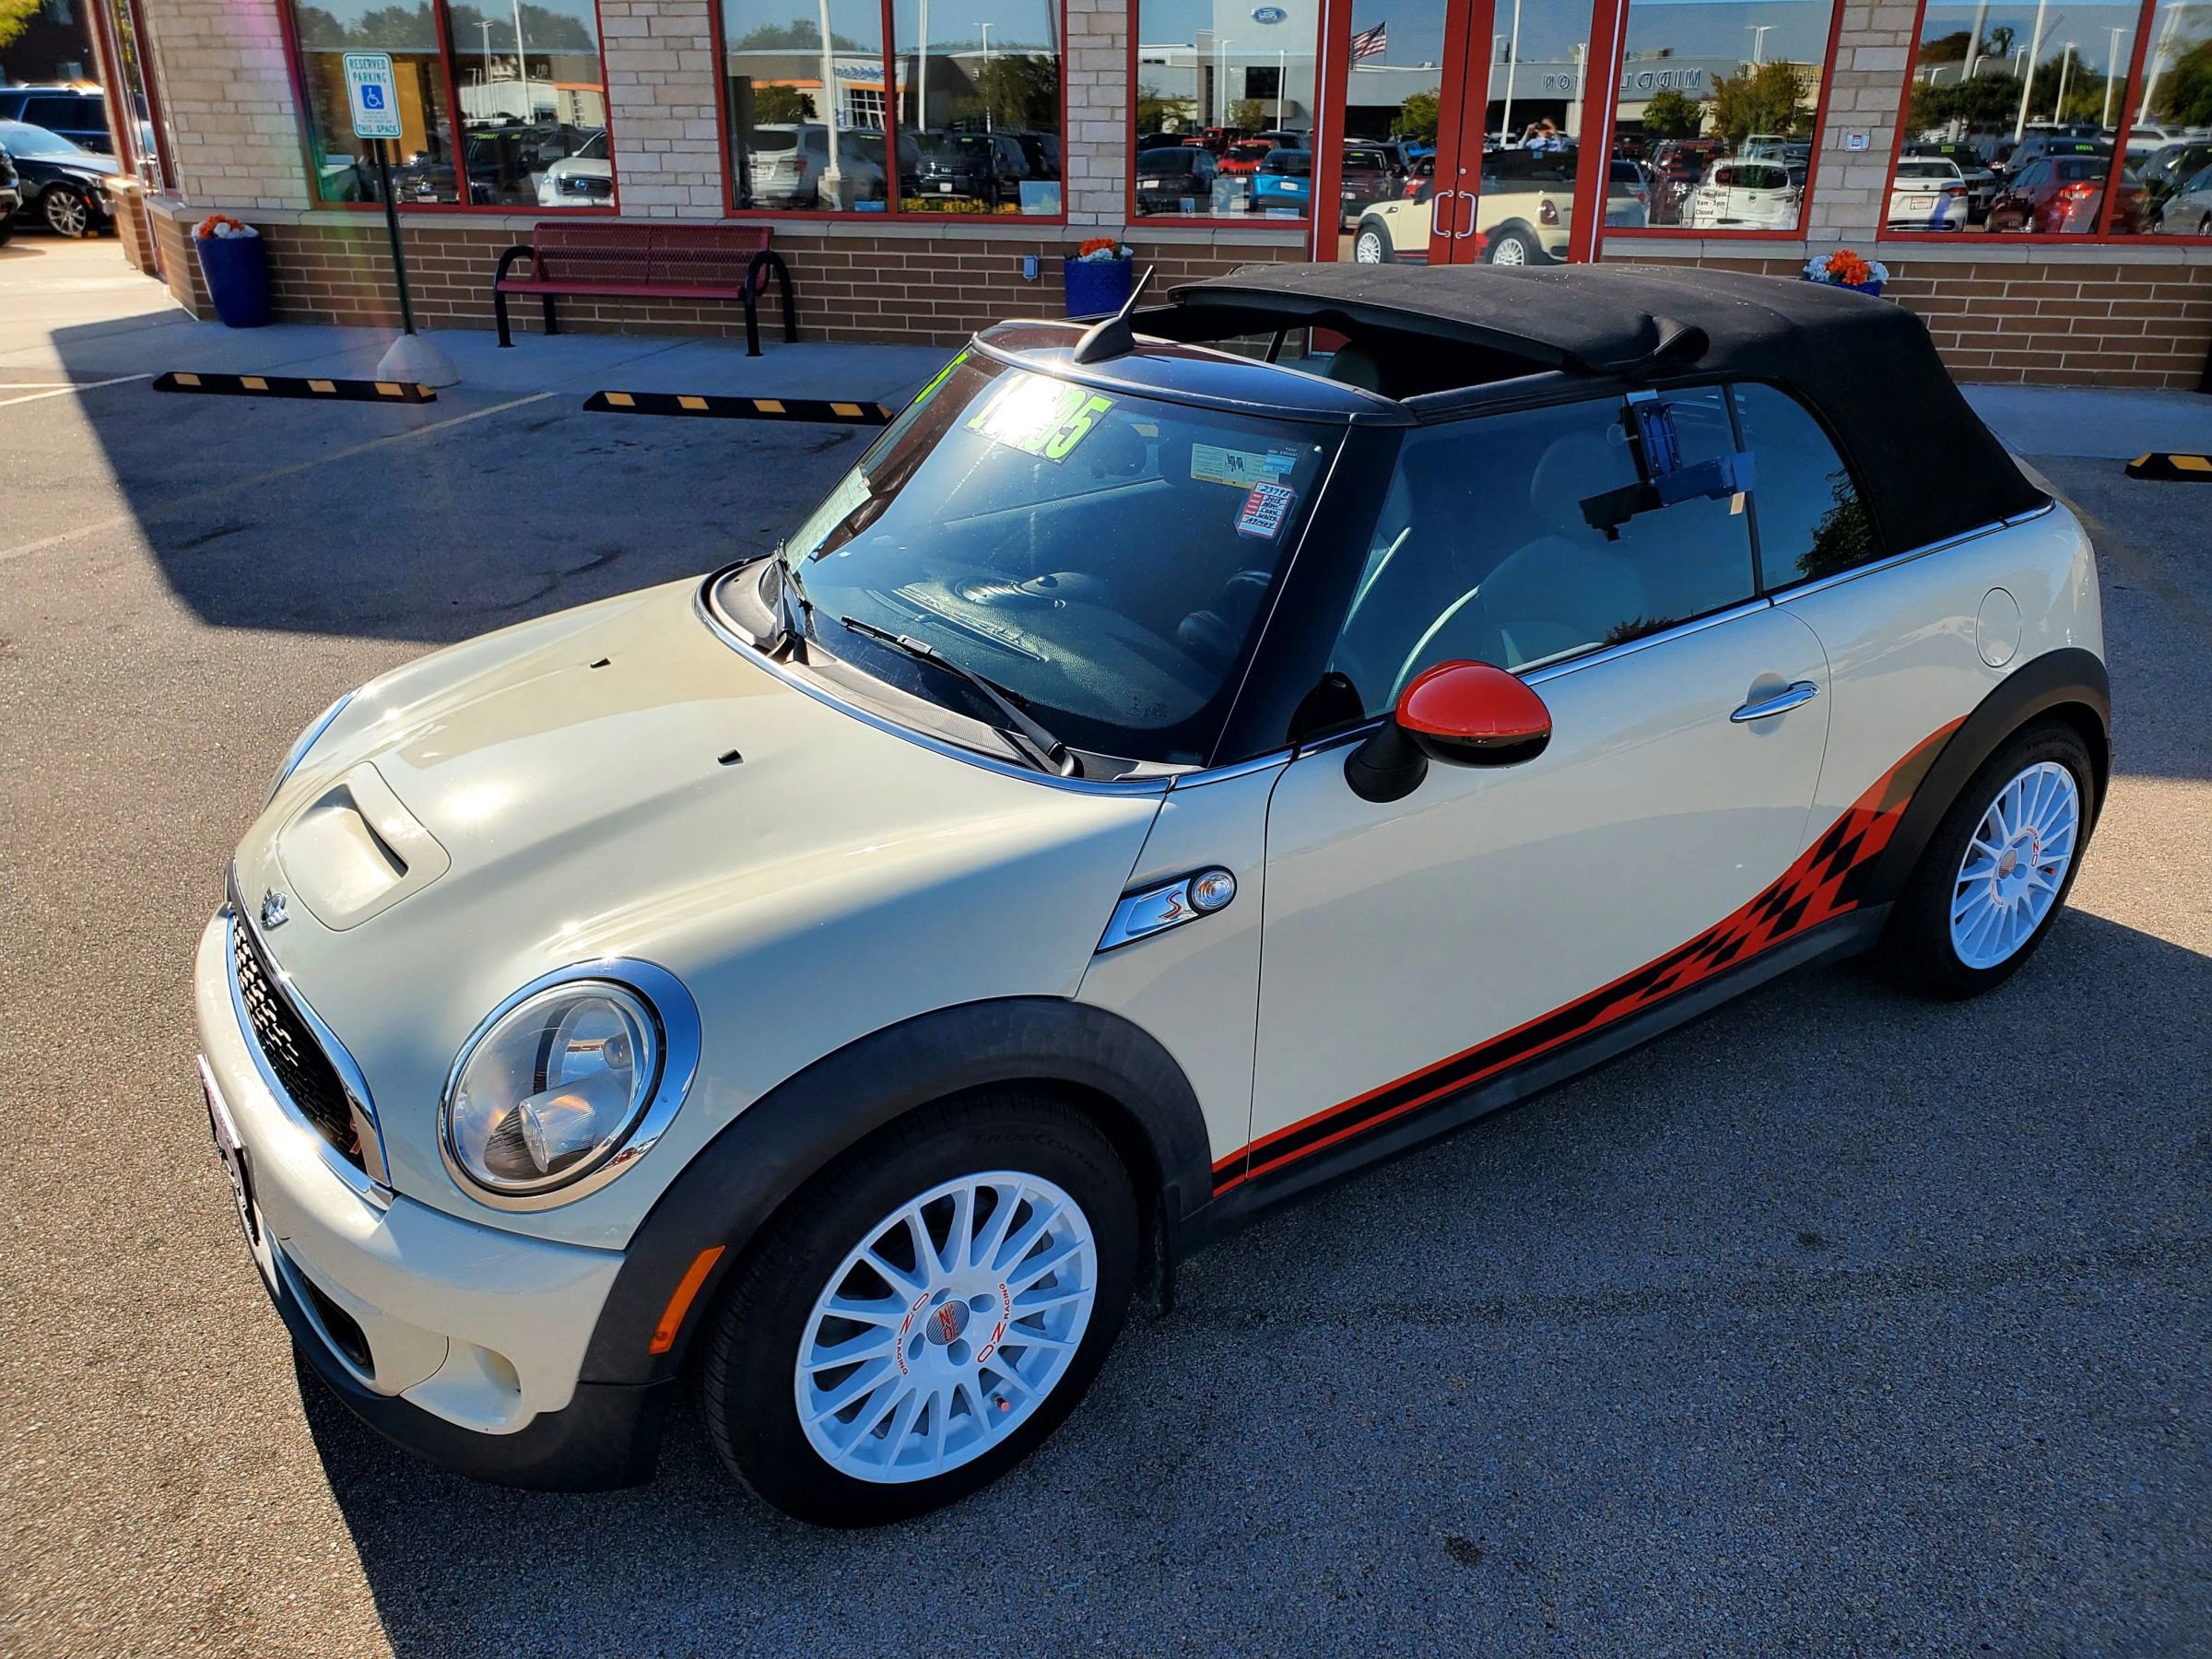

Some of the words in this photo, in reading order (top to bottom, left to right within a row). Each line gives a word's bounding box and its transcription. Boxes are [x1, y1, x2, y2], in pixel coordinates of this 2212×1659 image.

[349, 58, 386, 70] RESERVED
[353, 72, 387, 83] PARKING
[358, 124, 372, 134] THIS
[377, 124, 398, 134] SPACE
[1159, 889, 1183, 920] S
[998, 1282, 1010, 1320] RACING
[896, 1337, 909, 1375] RACING
